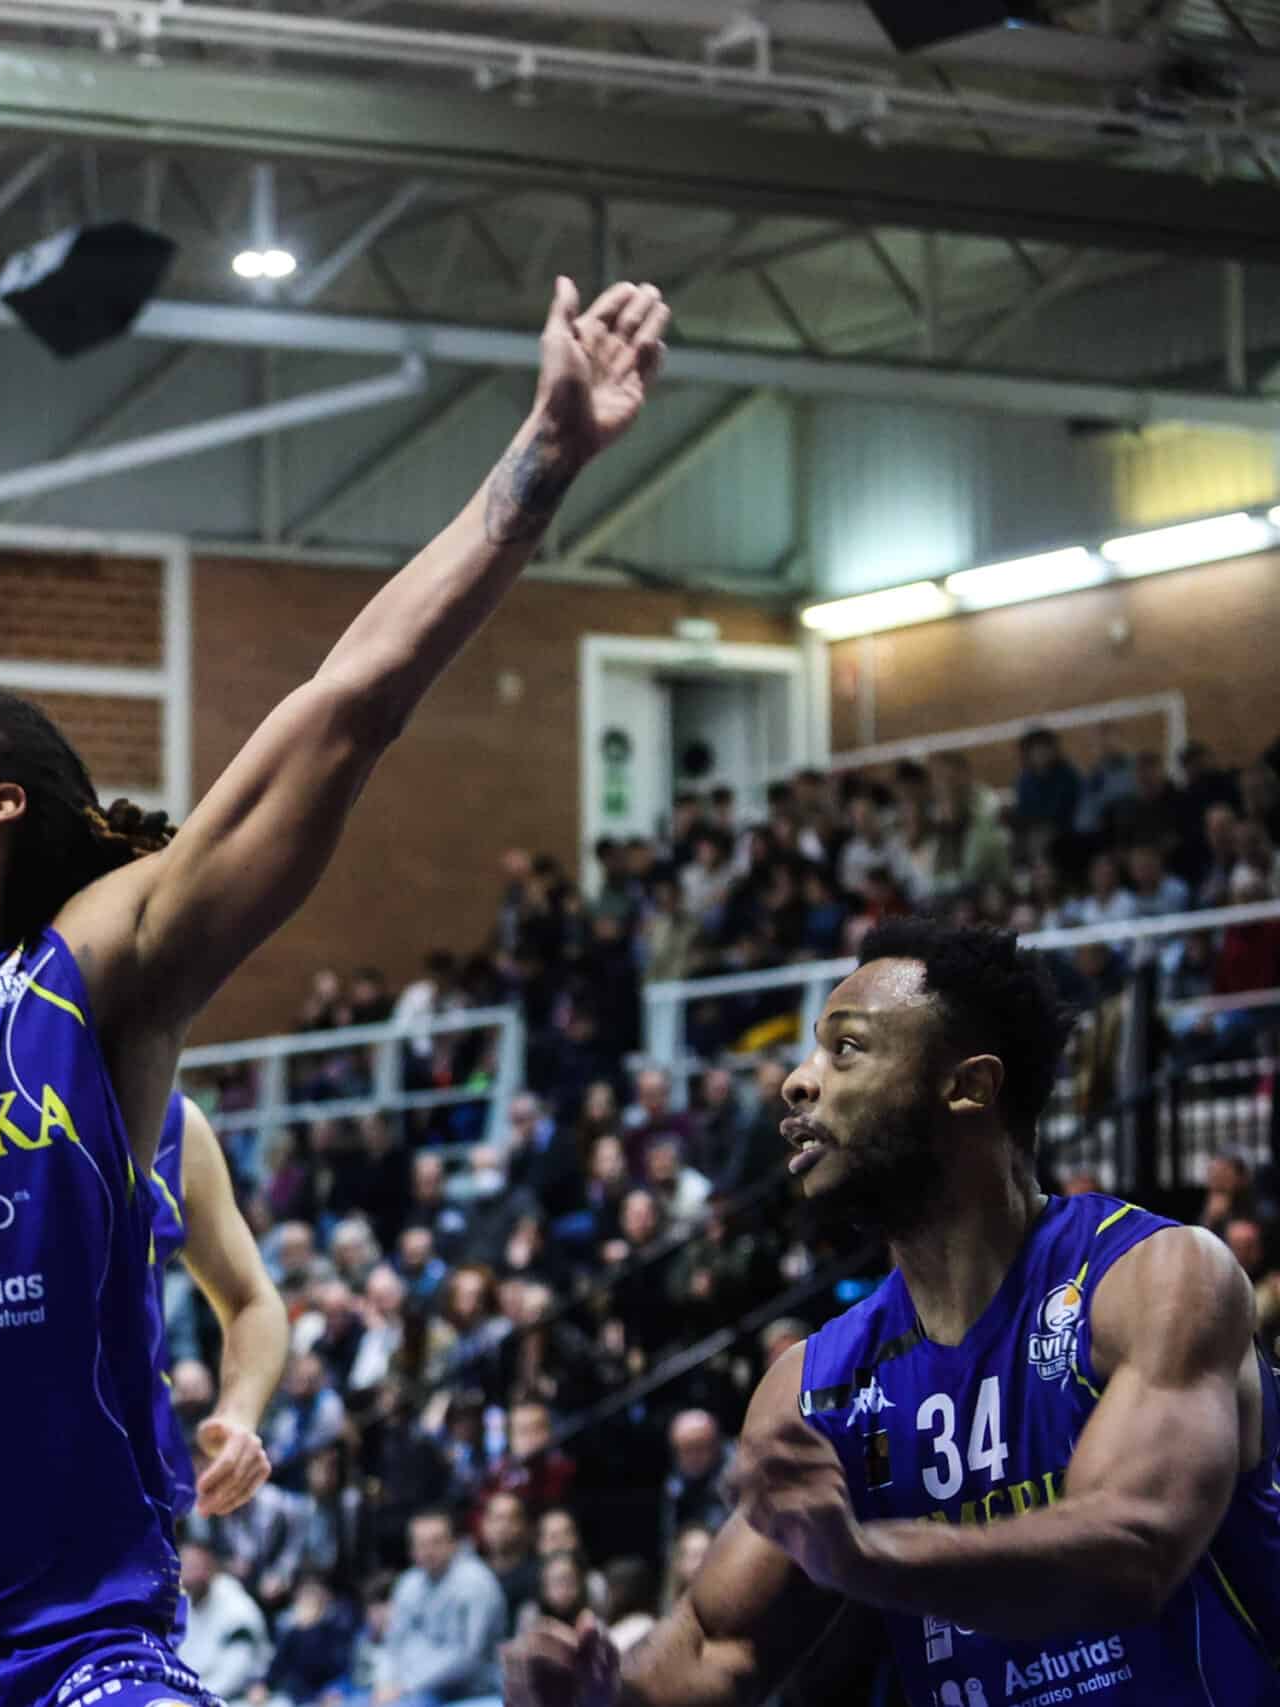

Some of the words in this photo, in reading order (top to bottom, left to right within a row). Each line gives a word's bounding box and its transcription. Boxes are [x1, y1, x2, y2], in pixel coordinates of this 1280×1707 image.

[915, 1375, 1009, 1500] 34
[1004, 1635, 1125, 1698] Asturias
[1076, 1664, 1134, 1696] natural
